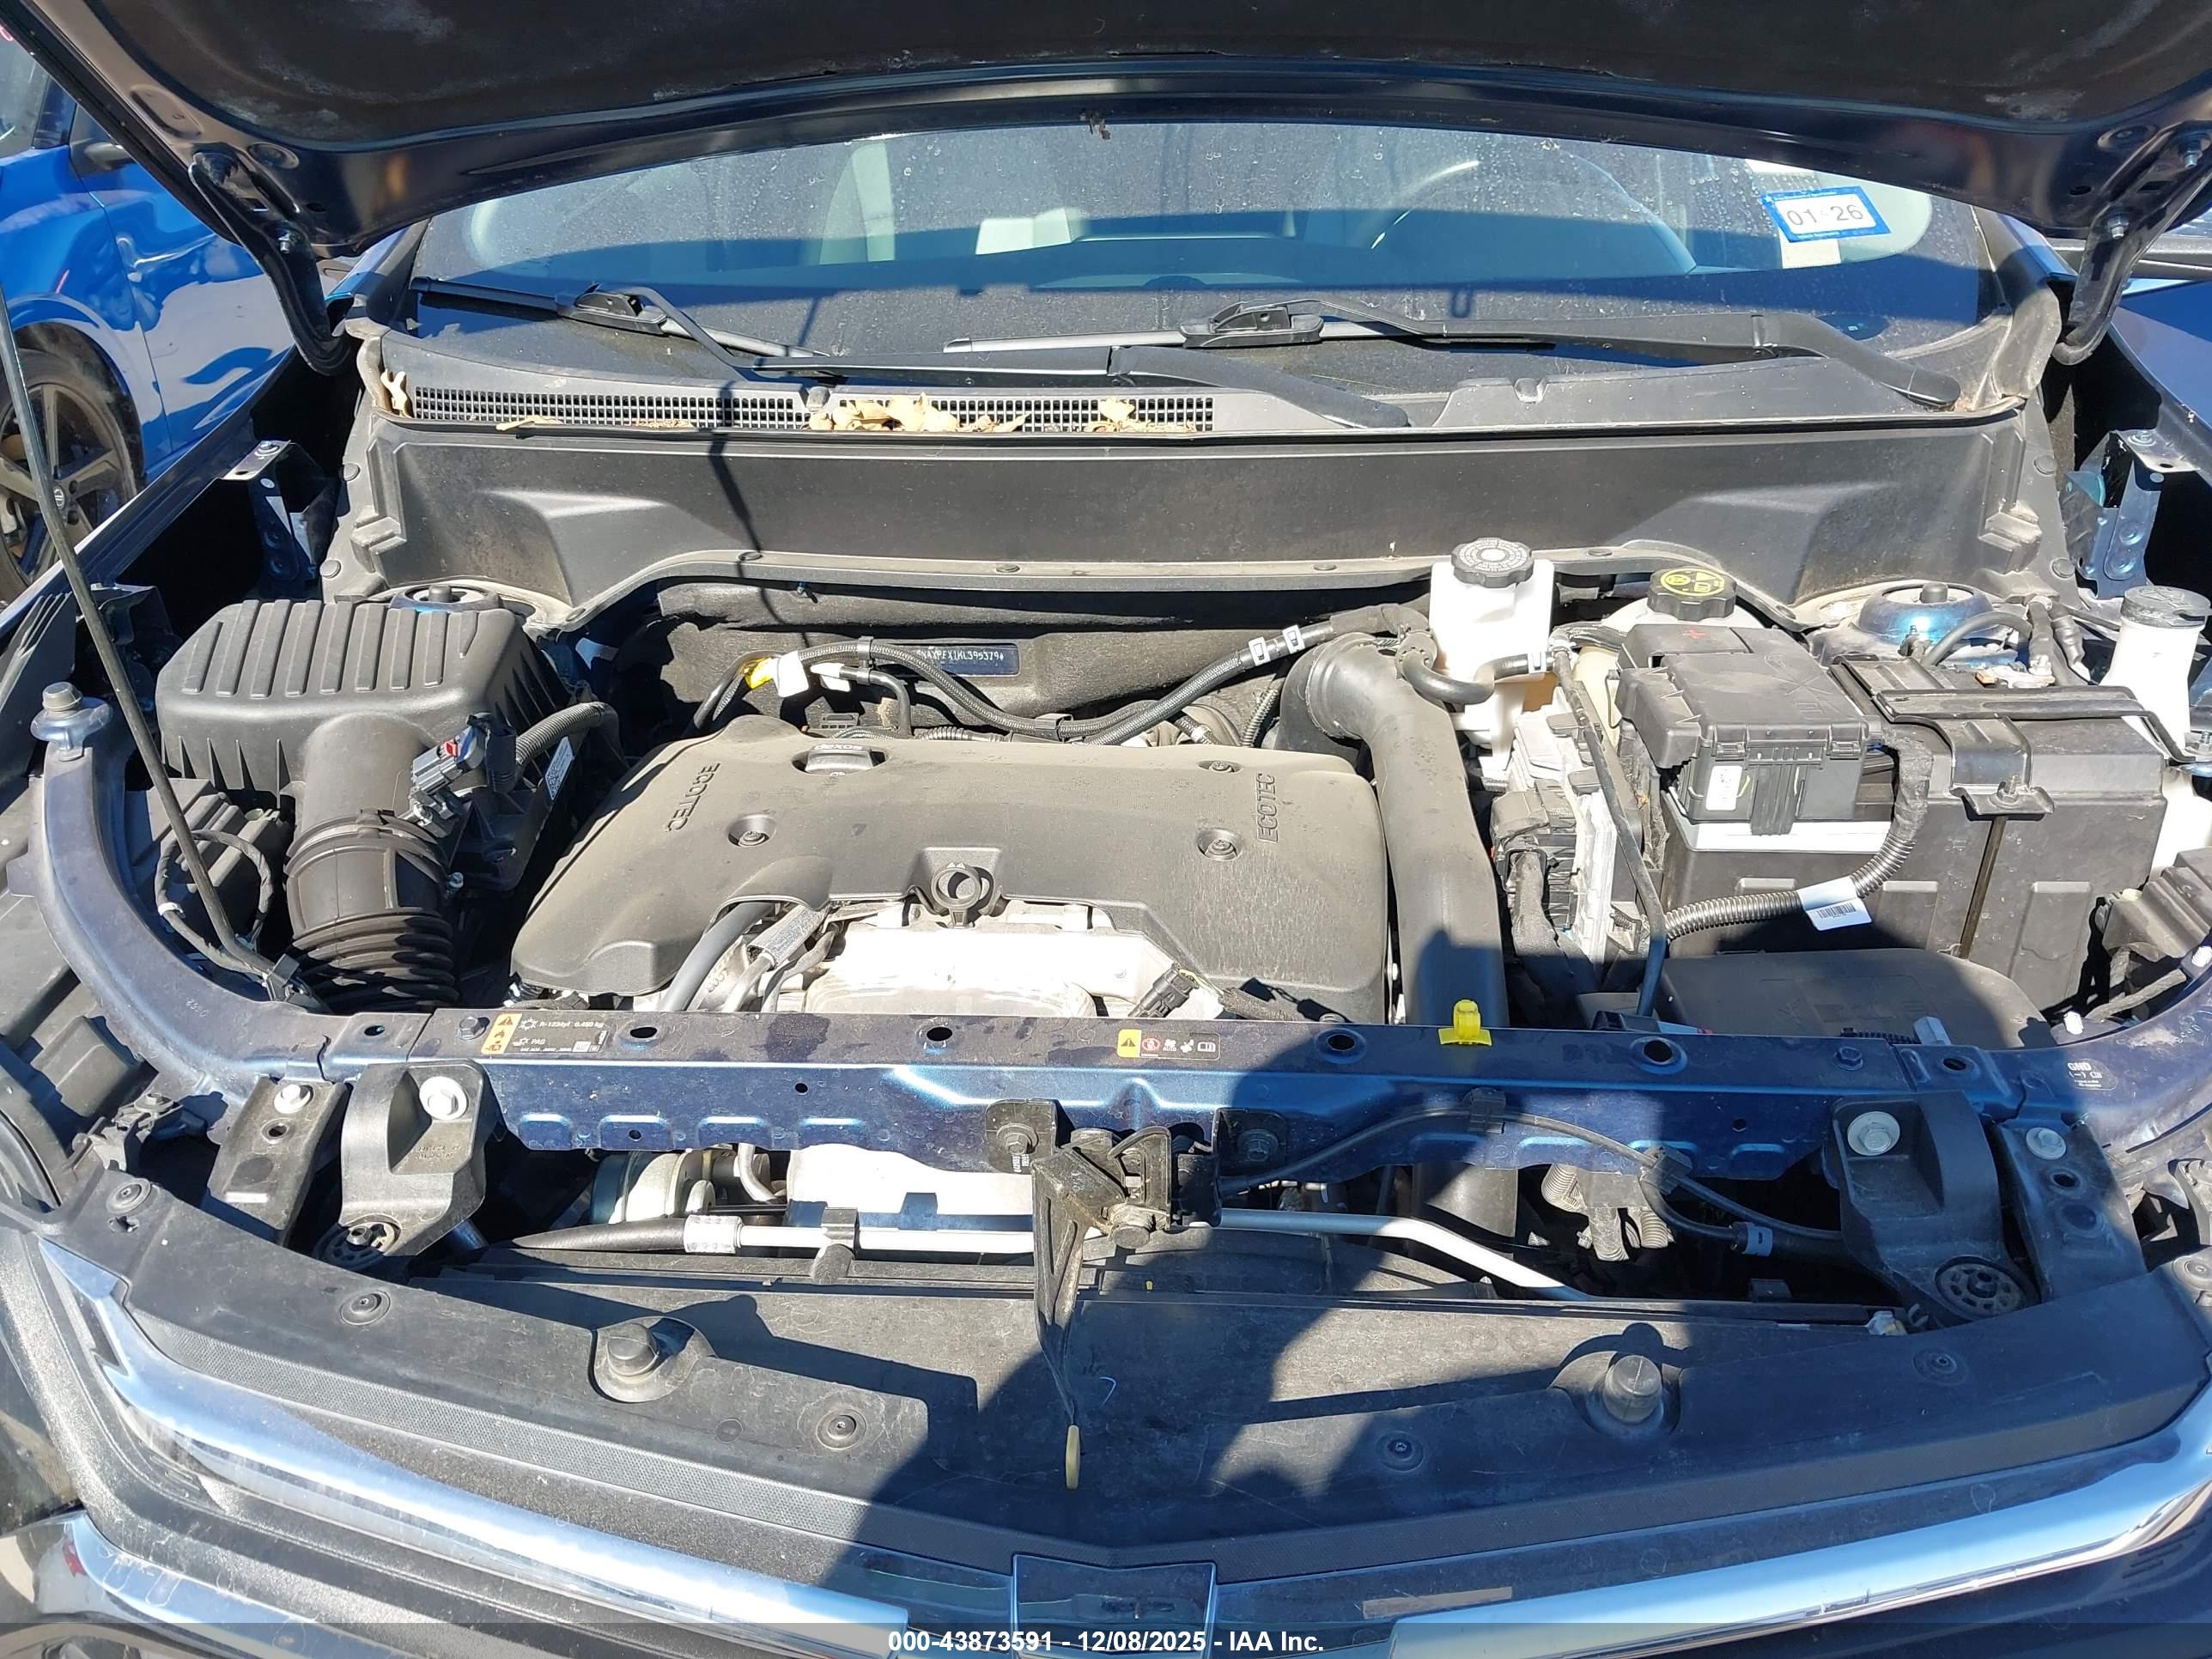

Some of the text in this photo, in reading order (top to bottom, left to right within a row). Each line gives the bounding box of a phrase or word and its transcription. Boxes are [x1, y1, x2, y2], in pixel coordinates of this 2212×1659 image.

[665, 762, 720, 833] ECOTEC
[1255, 773, 1279, 843] ECOTEC
[2067, 1062, 2092, 1071] GND
